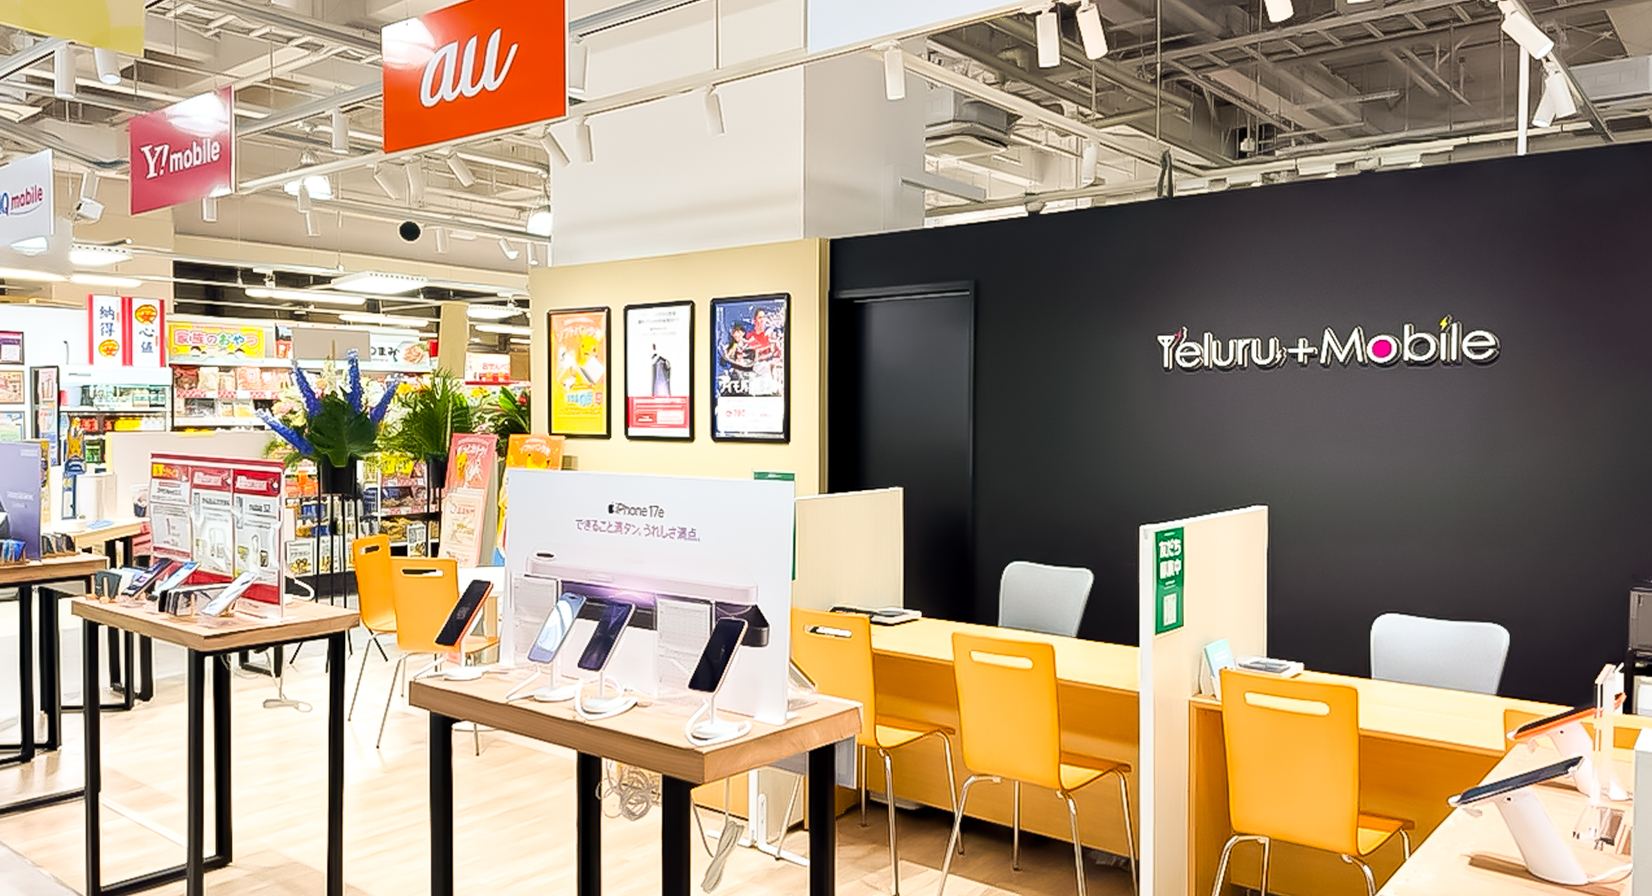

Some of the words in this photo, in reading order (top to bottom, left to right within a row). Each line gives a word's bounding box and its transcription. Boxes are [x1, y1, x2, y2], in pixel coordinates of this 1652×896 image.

[419, 28, 519, 108] au
[11, 184, 43, 211] mobile
[174, 329, 259, 348] 家族のおやつ
[615, 502, 647, 517] iPhone
[649, 505, 664, 518] 17e
